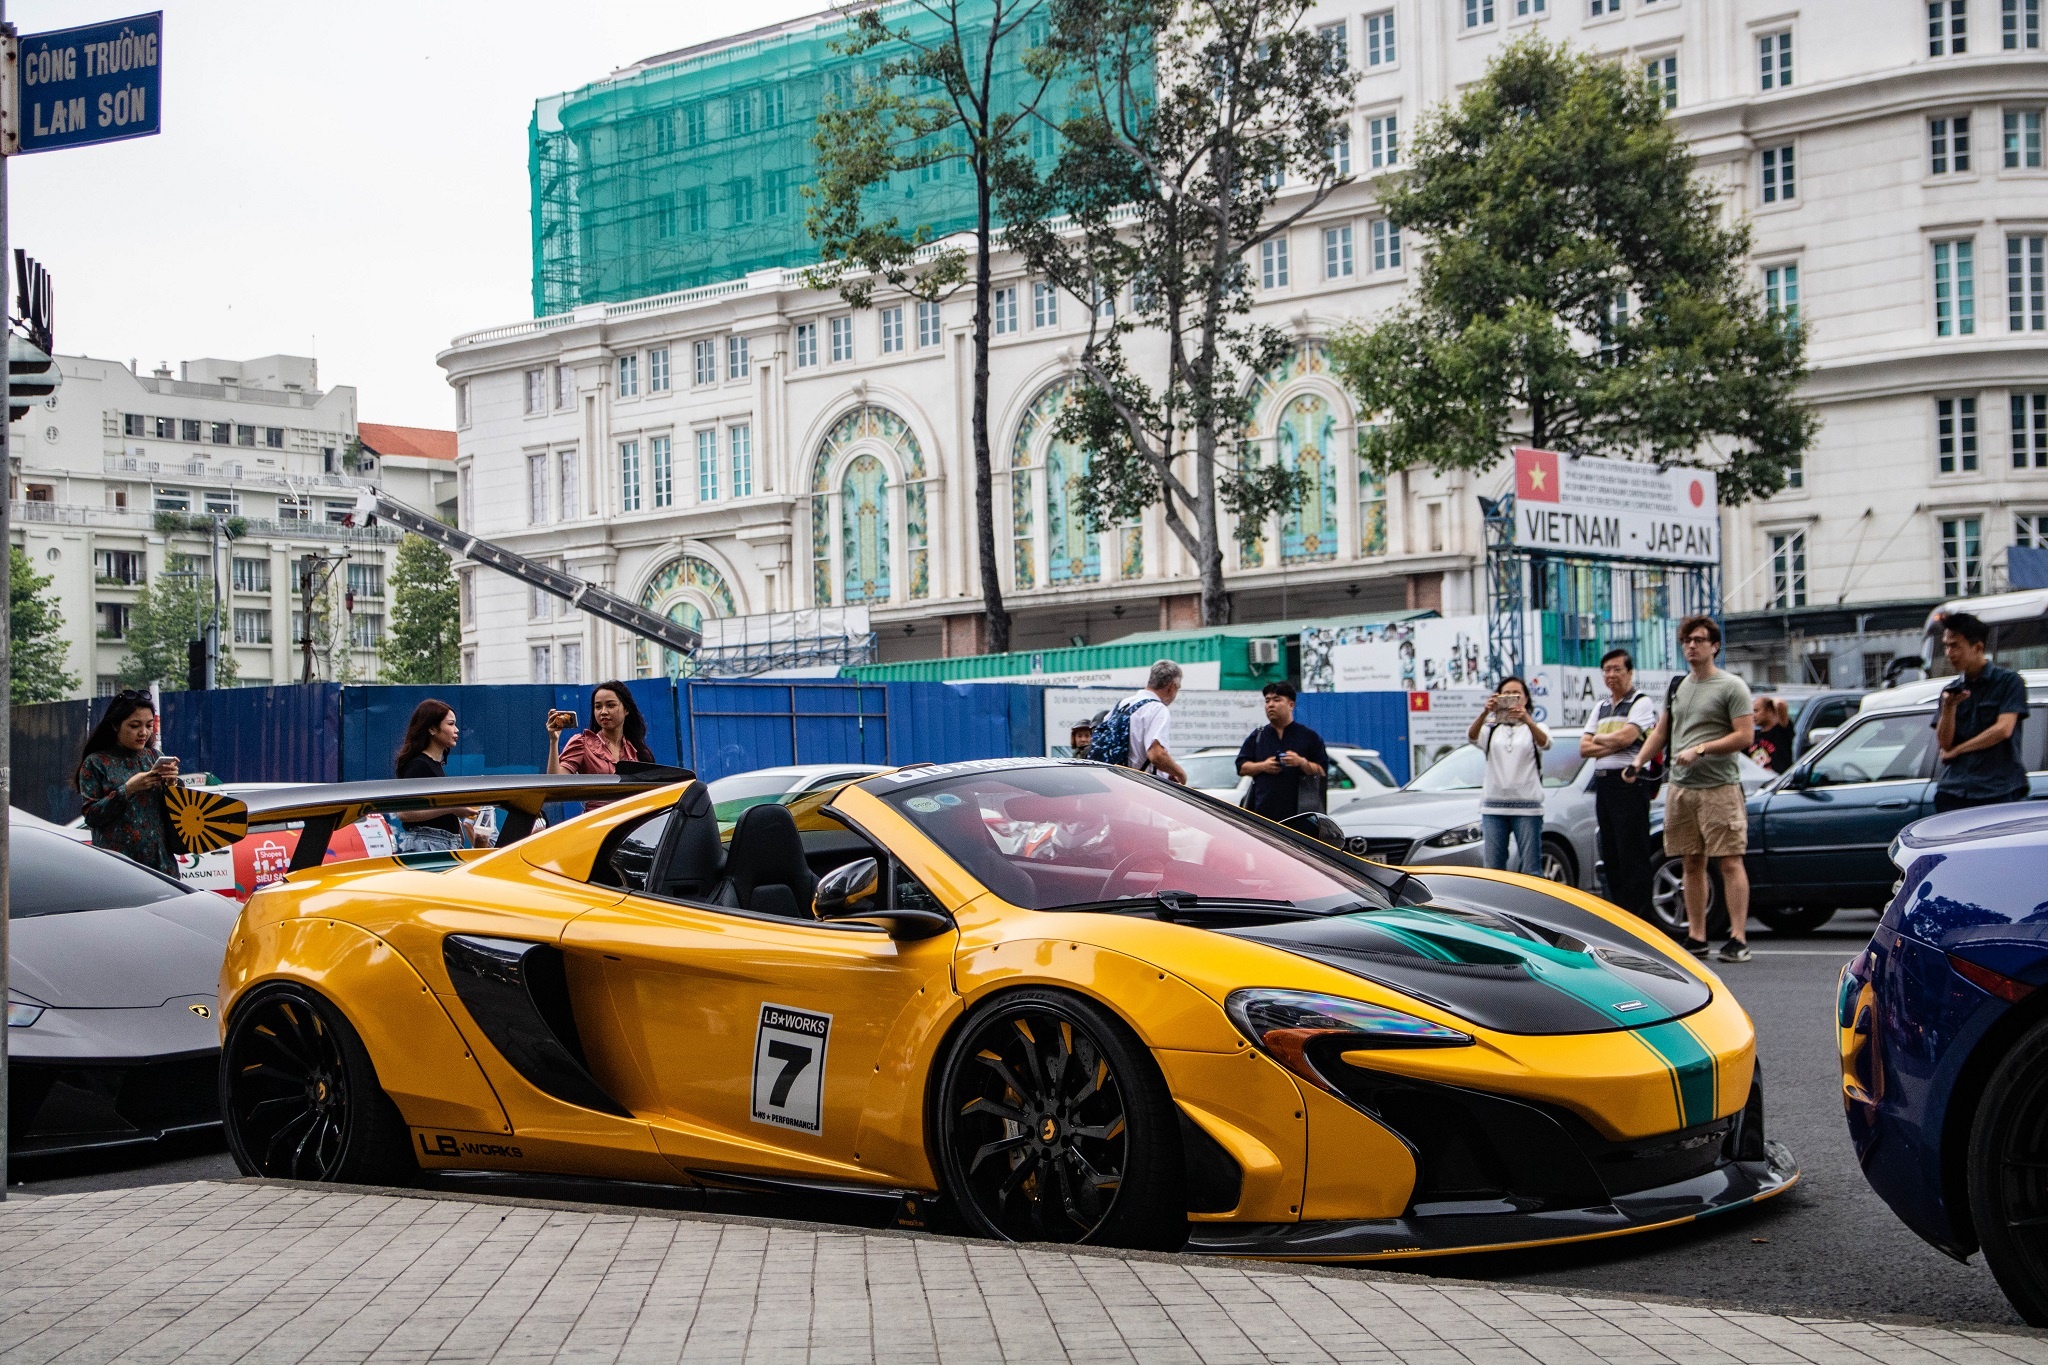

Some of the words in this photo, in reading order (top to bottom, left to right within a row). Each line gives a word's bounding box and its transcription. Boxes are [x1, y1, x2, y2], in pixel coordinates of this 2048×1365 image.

[25, 42, 77, 86] CÔNG
[84, 26, 157, 78] TRƯỜNG
[33, 96, 86, 137] LAM
[98, 82, 146, 127] SƠN
[1526, 509, 1620, 548] VIETNAM
[1646, 521, 1712, 555] JAPAN
[1051, 677, 1071, 685] JOINT
[1072, 674, 1111, 683] OPERATION
[260, 851, 283, 859] Shopee
[253, 858, 291, 874] 11.11
[273, 873, 287, 881] SA
[768, 1039, 812, 1108] 7
[771, 1113, 815, 1131] PERFORMANCE
